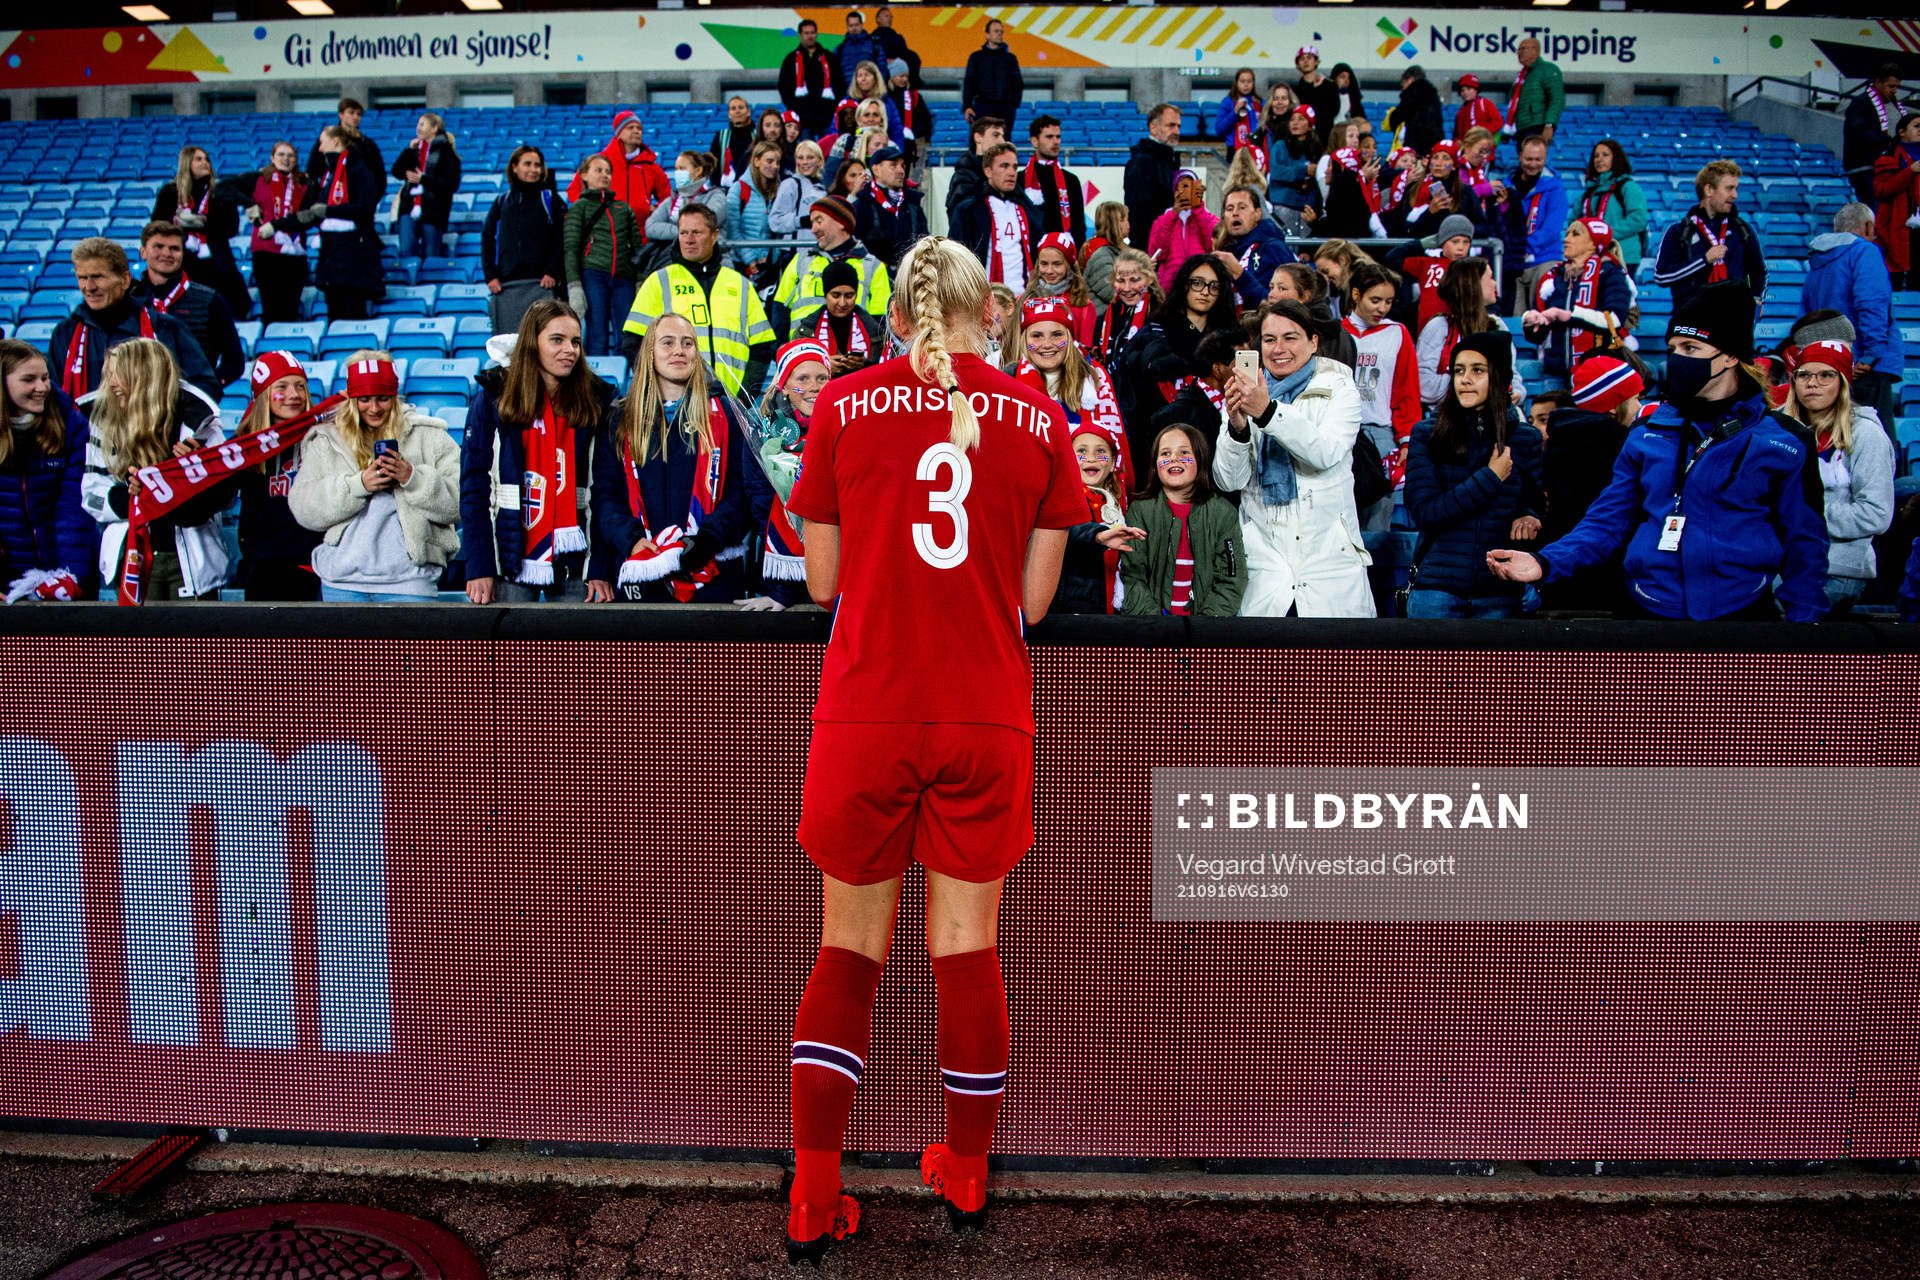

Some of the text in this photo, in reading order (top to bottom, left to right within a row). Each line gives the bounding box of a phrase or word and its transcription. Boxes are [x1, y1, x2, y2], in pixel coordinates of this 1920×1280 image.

[284, 25, 552, 67] Gi drømmen en sjanse!
[1430, 25, 1519, 53] Norsk
[674, 285, 695, 295] 528
[1674, 326, 1697, 336] PSS
[911, 442, 973, 570] 3
[624, 585, 642, 600] VS
